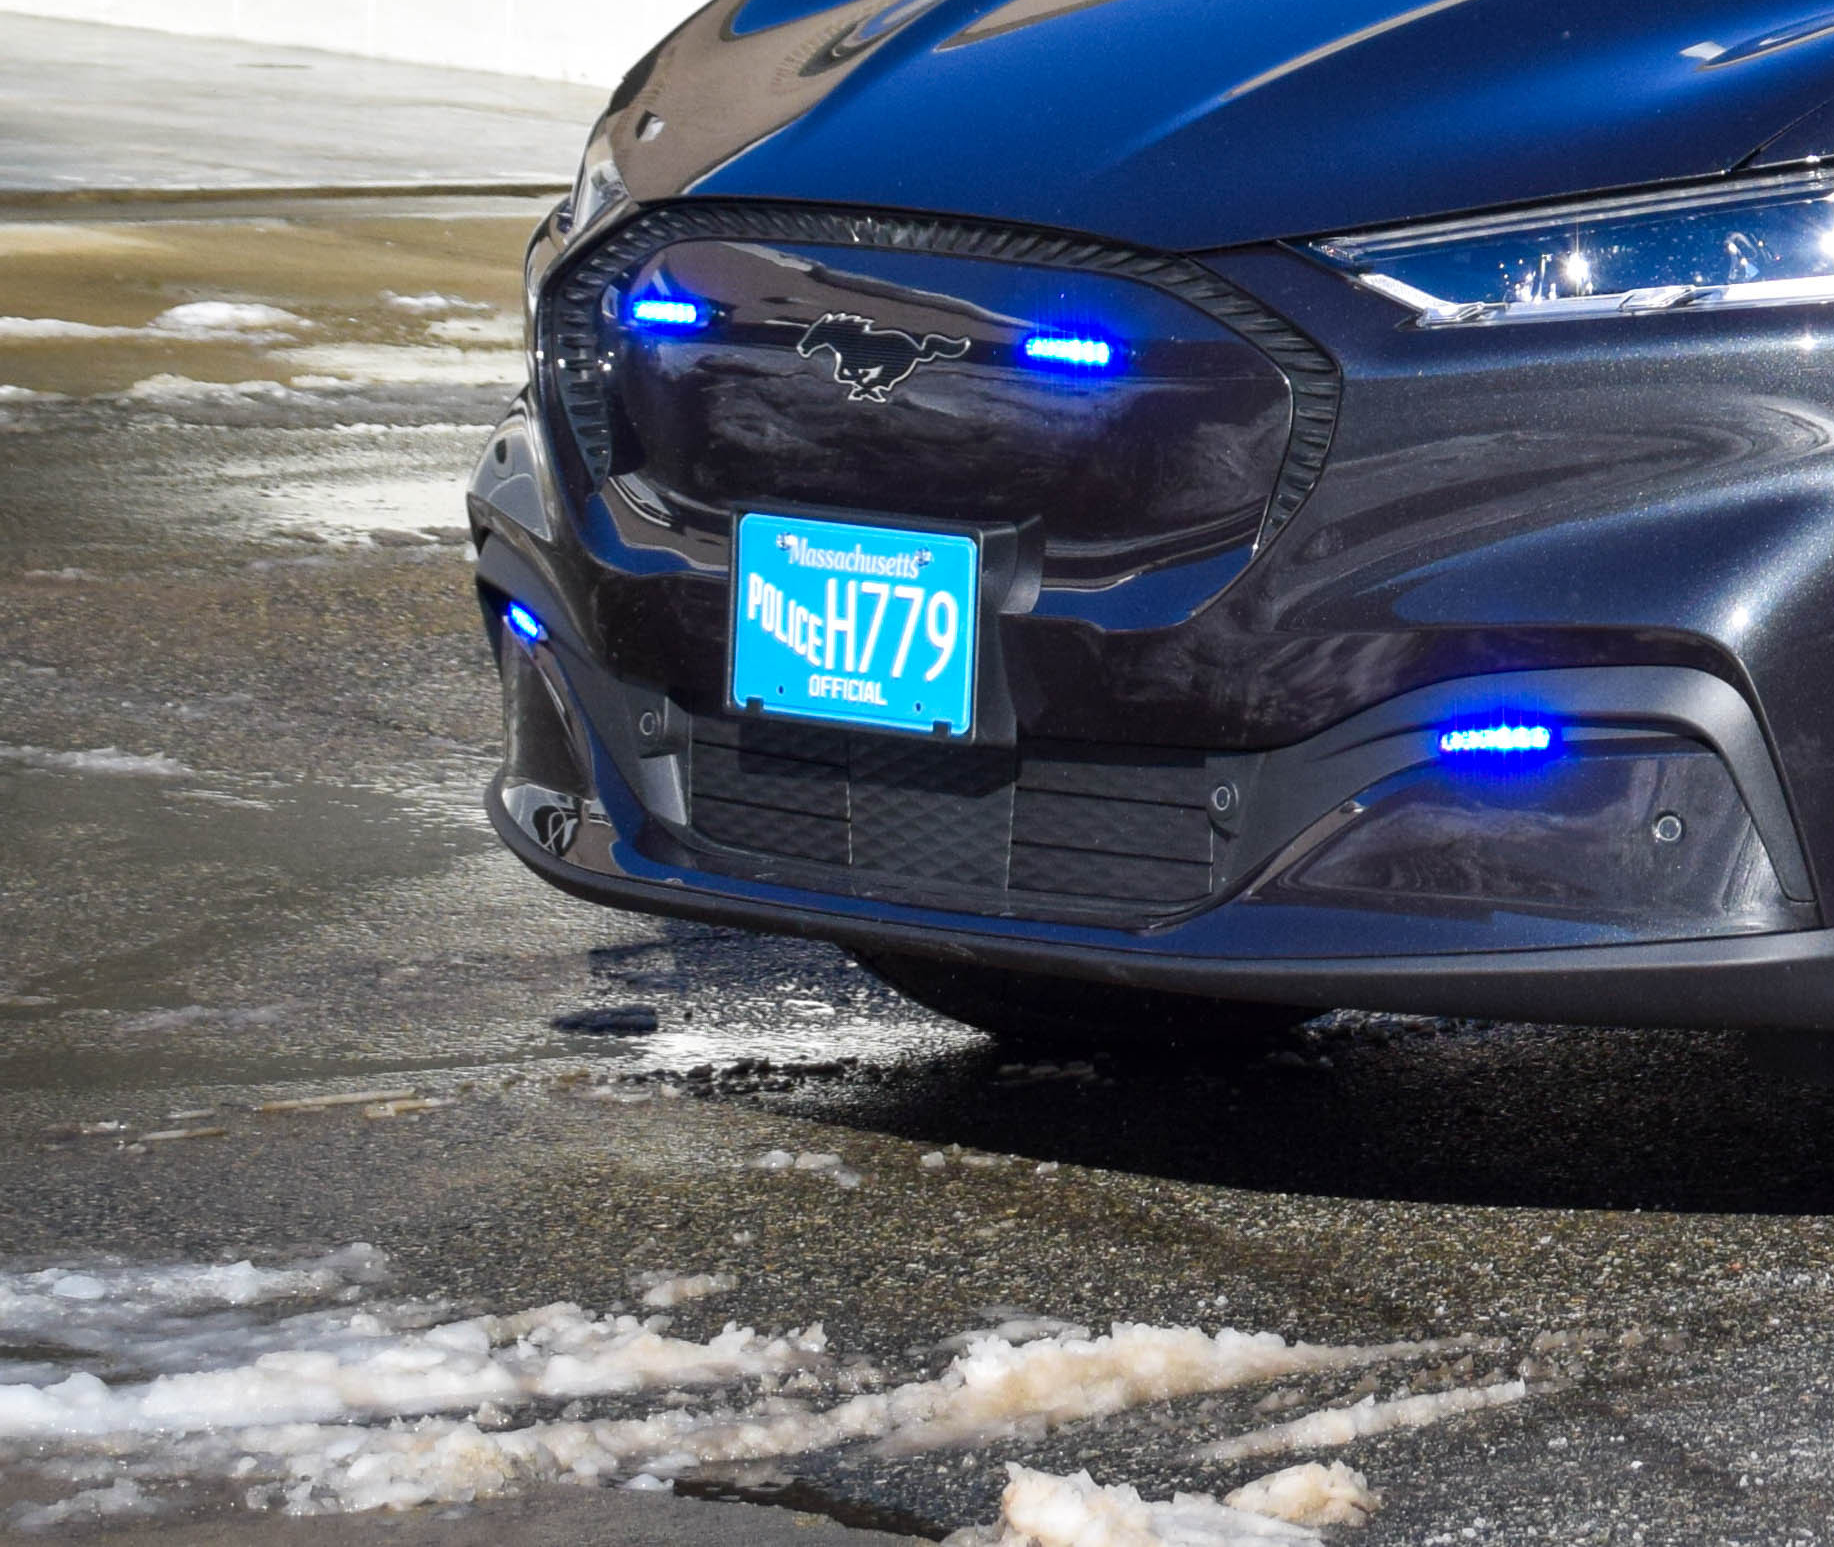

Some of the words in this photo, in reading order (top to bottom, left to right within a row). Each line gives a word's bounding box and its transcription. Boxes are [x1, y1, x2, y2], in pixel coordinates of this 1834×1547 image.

[788, 537, 920, 580] Massachusetts
[748, 572, 823, 668] POLICE
[824, 577, 960, 683] H779
[808, 674, 888, 706] OFFICIAL
